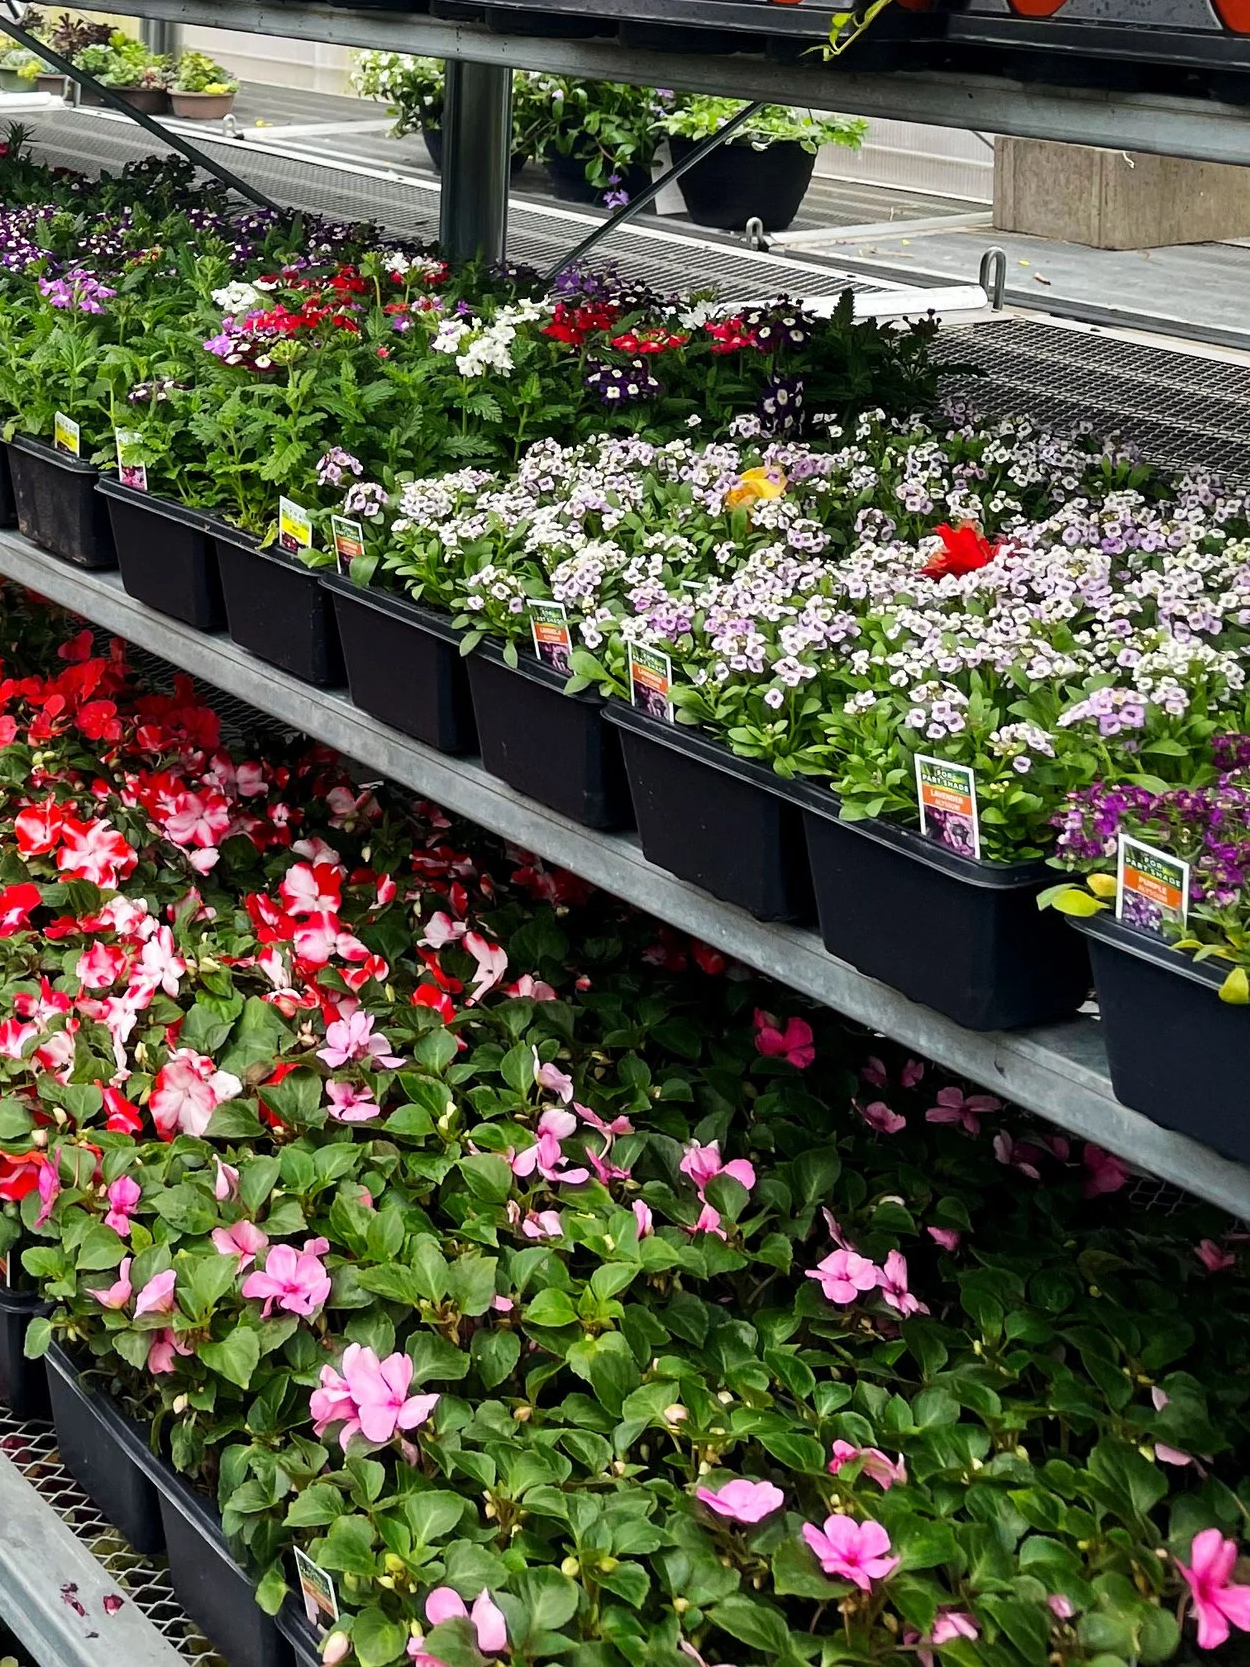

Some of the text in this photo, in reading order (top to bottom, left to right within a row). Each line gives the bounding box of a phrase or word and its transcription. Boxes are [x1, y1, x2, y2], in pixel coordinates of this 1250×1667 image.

[922, 773, 969, 793] PART SHADE
[1125, 856, 1181, 888] PART SHADE
[1144, 857, 1163, 870] FOR
